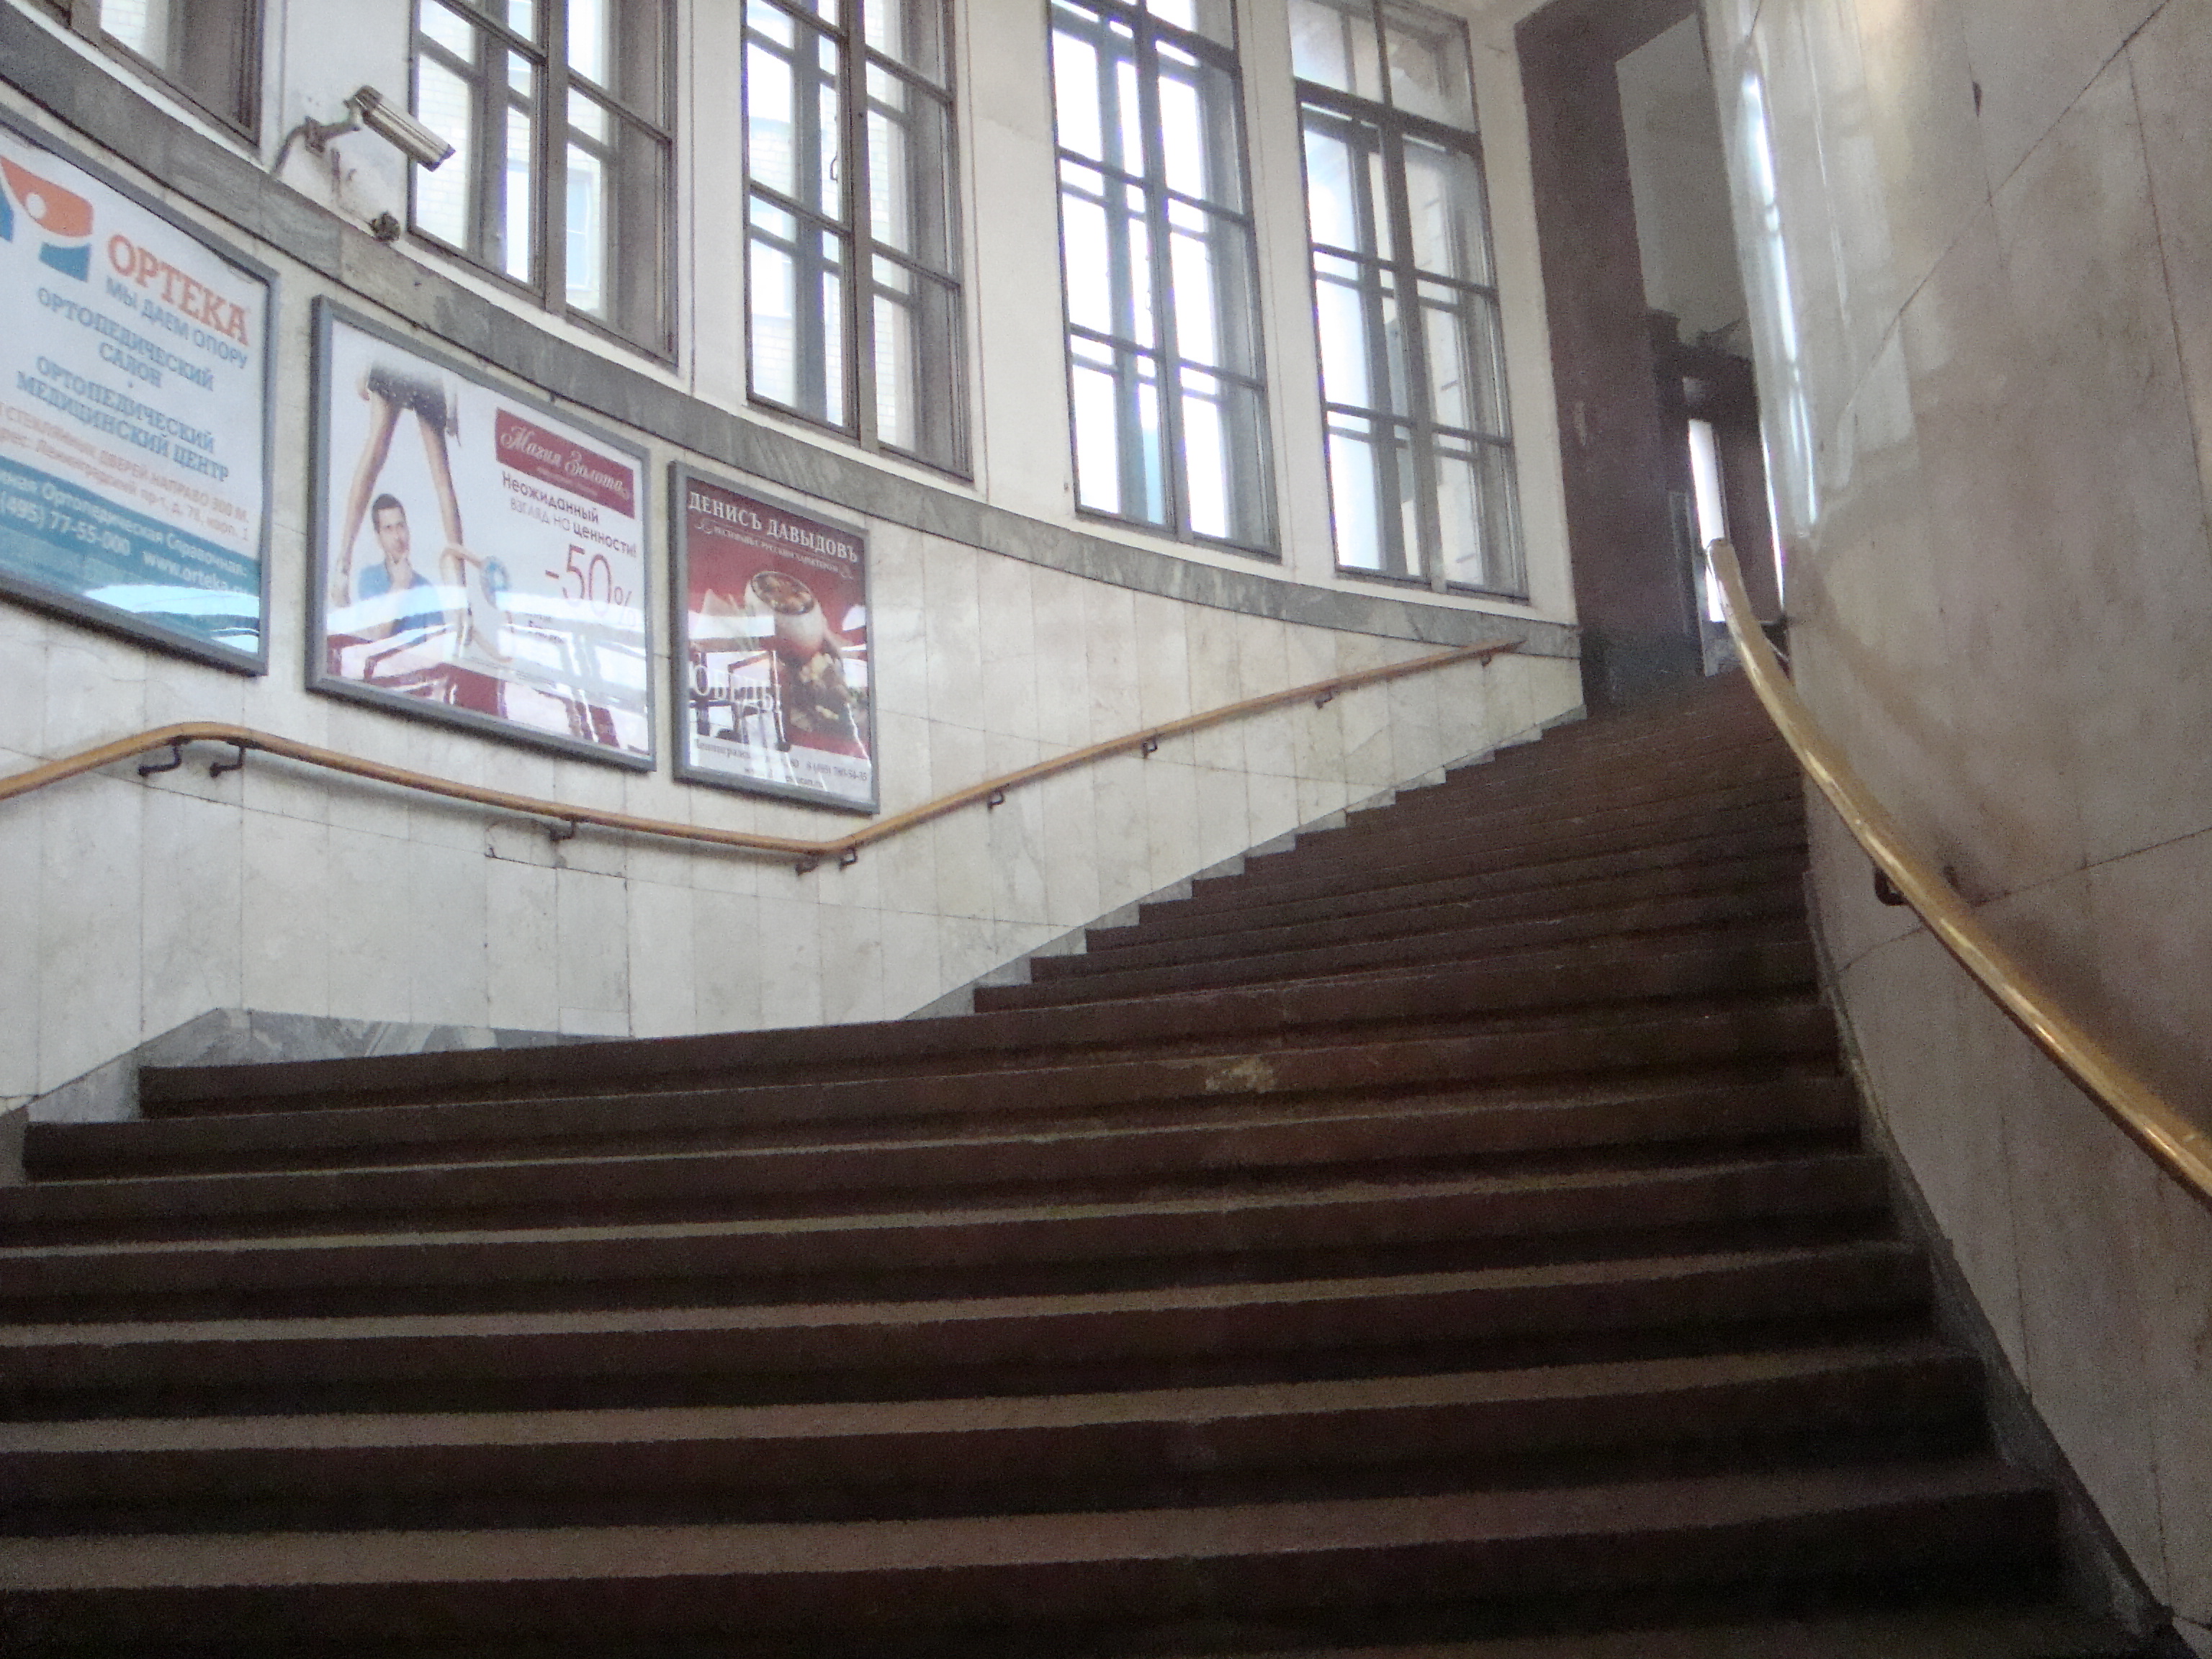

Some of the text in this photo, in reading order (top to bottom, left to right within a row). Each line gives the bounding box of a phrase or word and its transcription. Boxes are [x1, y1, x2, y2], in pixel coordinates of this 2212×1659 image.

[106, 275, 248, 369] МЫ ДАЕМ ОПОРУ
[107, 233, 249, 346] ОРТЕКА
[37, 287, 215, 391] ОРТОПЕДИЧЕСКИЙ
[99, 341, 163, 388] САЛОН
[16, 369, 230, 482] МЕДИЦИНСКИЙ ЦЕНТР
[36, 356, 215, 453] ОРТОПЕДИЧЕСКИЙ
[500, 426, 562, 468] Магия
[565, 450, 630, 500] Золота
[503, 469, 599, 526] Неожиданный
[42, 480, 164, 545] Ортопедическая
[511, 495, 550, 525] взгляд
[573, 521, 637, 559] ценности!
[688, 491, 858, 564] ДЕНИСЪ ДАВЫДОВЪ
